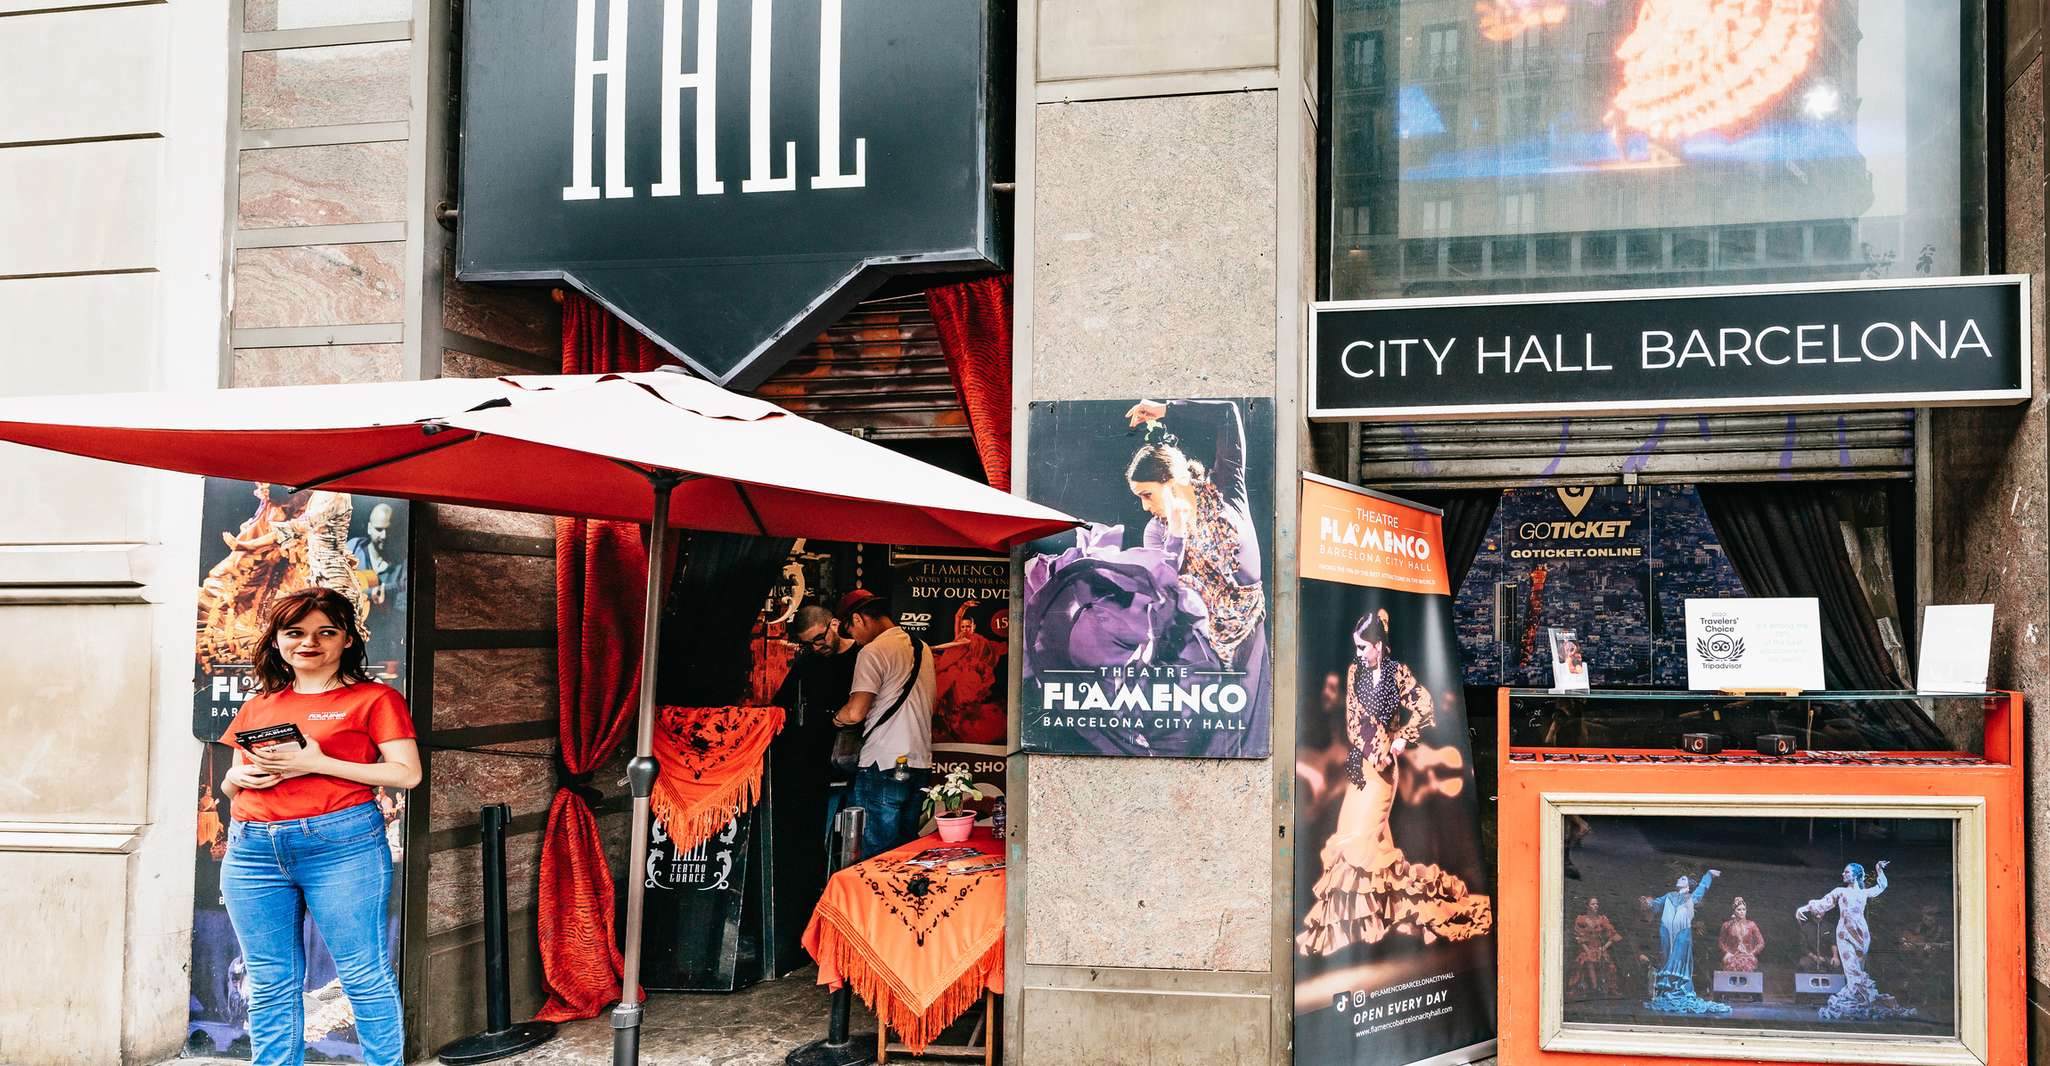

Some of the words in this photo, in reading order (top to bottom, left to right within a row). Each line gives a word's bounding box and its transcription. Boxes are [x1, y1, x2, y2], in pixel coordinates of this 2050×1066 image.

[562, 0, 866, 201] HALL
[1340, 335, 1458, 379] CITY
[1477, 332, 1613, 375] HALL
[1641, 317, 1994, 370] BARCELONA
[1356, 507, 1399, 528] THEATRE
[1320, 515, 1431, 560] FLAMENCO
[1519, 520, 1631, 540] GOTICKET
[1319, 544, 1382, 565] BARCELONA
[1385, 557, 1404, 567] CITY
[1408, 562, 1432, 572] HALL
[1510, 547, 1642, 558] GOTICKET.ONLINE
[923, 563, 1004, 577] FLAMENCO
[912, 586, 941, 598] BUY
[944, 587, 977, 599] OUR
[900, 612, 932, 621] DVD
[1100, 667, 1188, 678] THEATRE
[1043, 681, 1248, 714] FLAMENCO
[1043, 716, 1145, 729] BARCELONA
[1154, 718, 1193, 729] CITY
[1203, 719, 1247, 730] HALL
[974, 761, 1007, 773] SHO
[671, 863, 707, 873] TEATRO
[1370, 971, 1455, 999] @FLAMENCOBARCELONACITYHALL
[1353, 1006, 1383, 1025] OPEN
[1388, 996, 1422, 1016] EVERY
[1426, 989, 1448, 1006] DAY
[1356, 1006, 1453, 1038] www.flamencobarcelonacityhall.com
